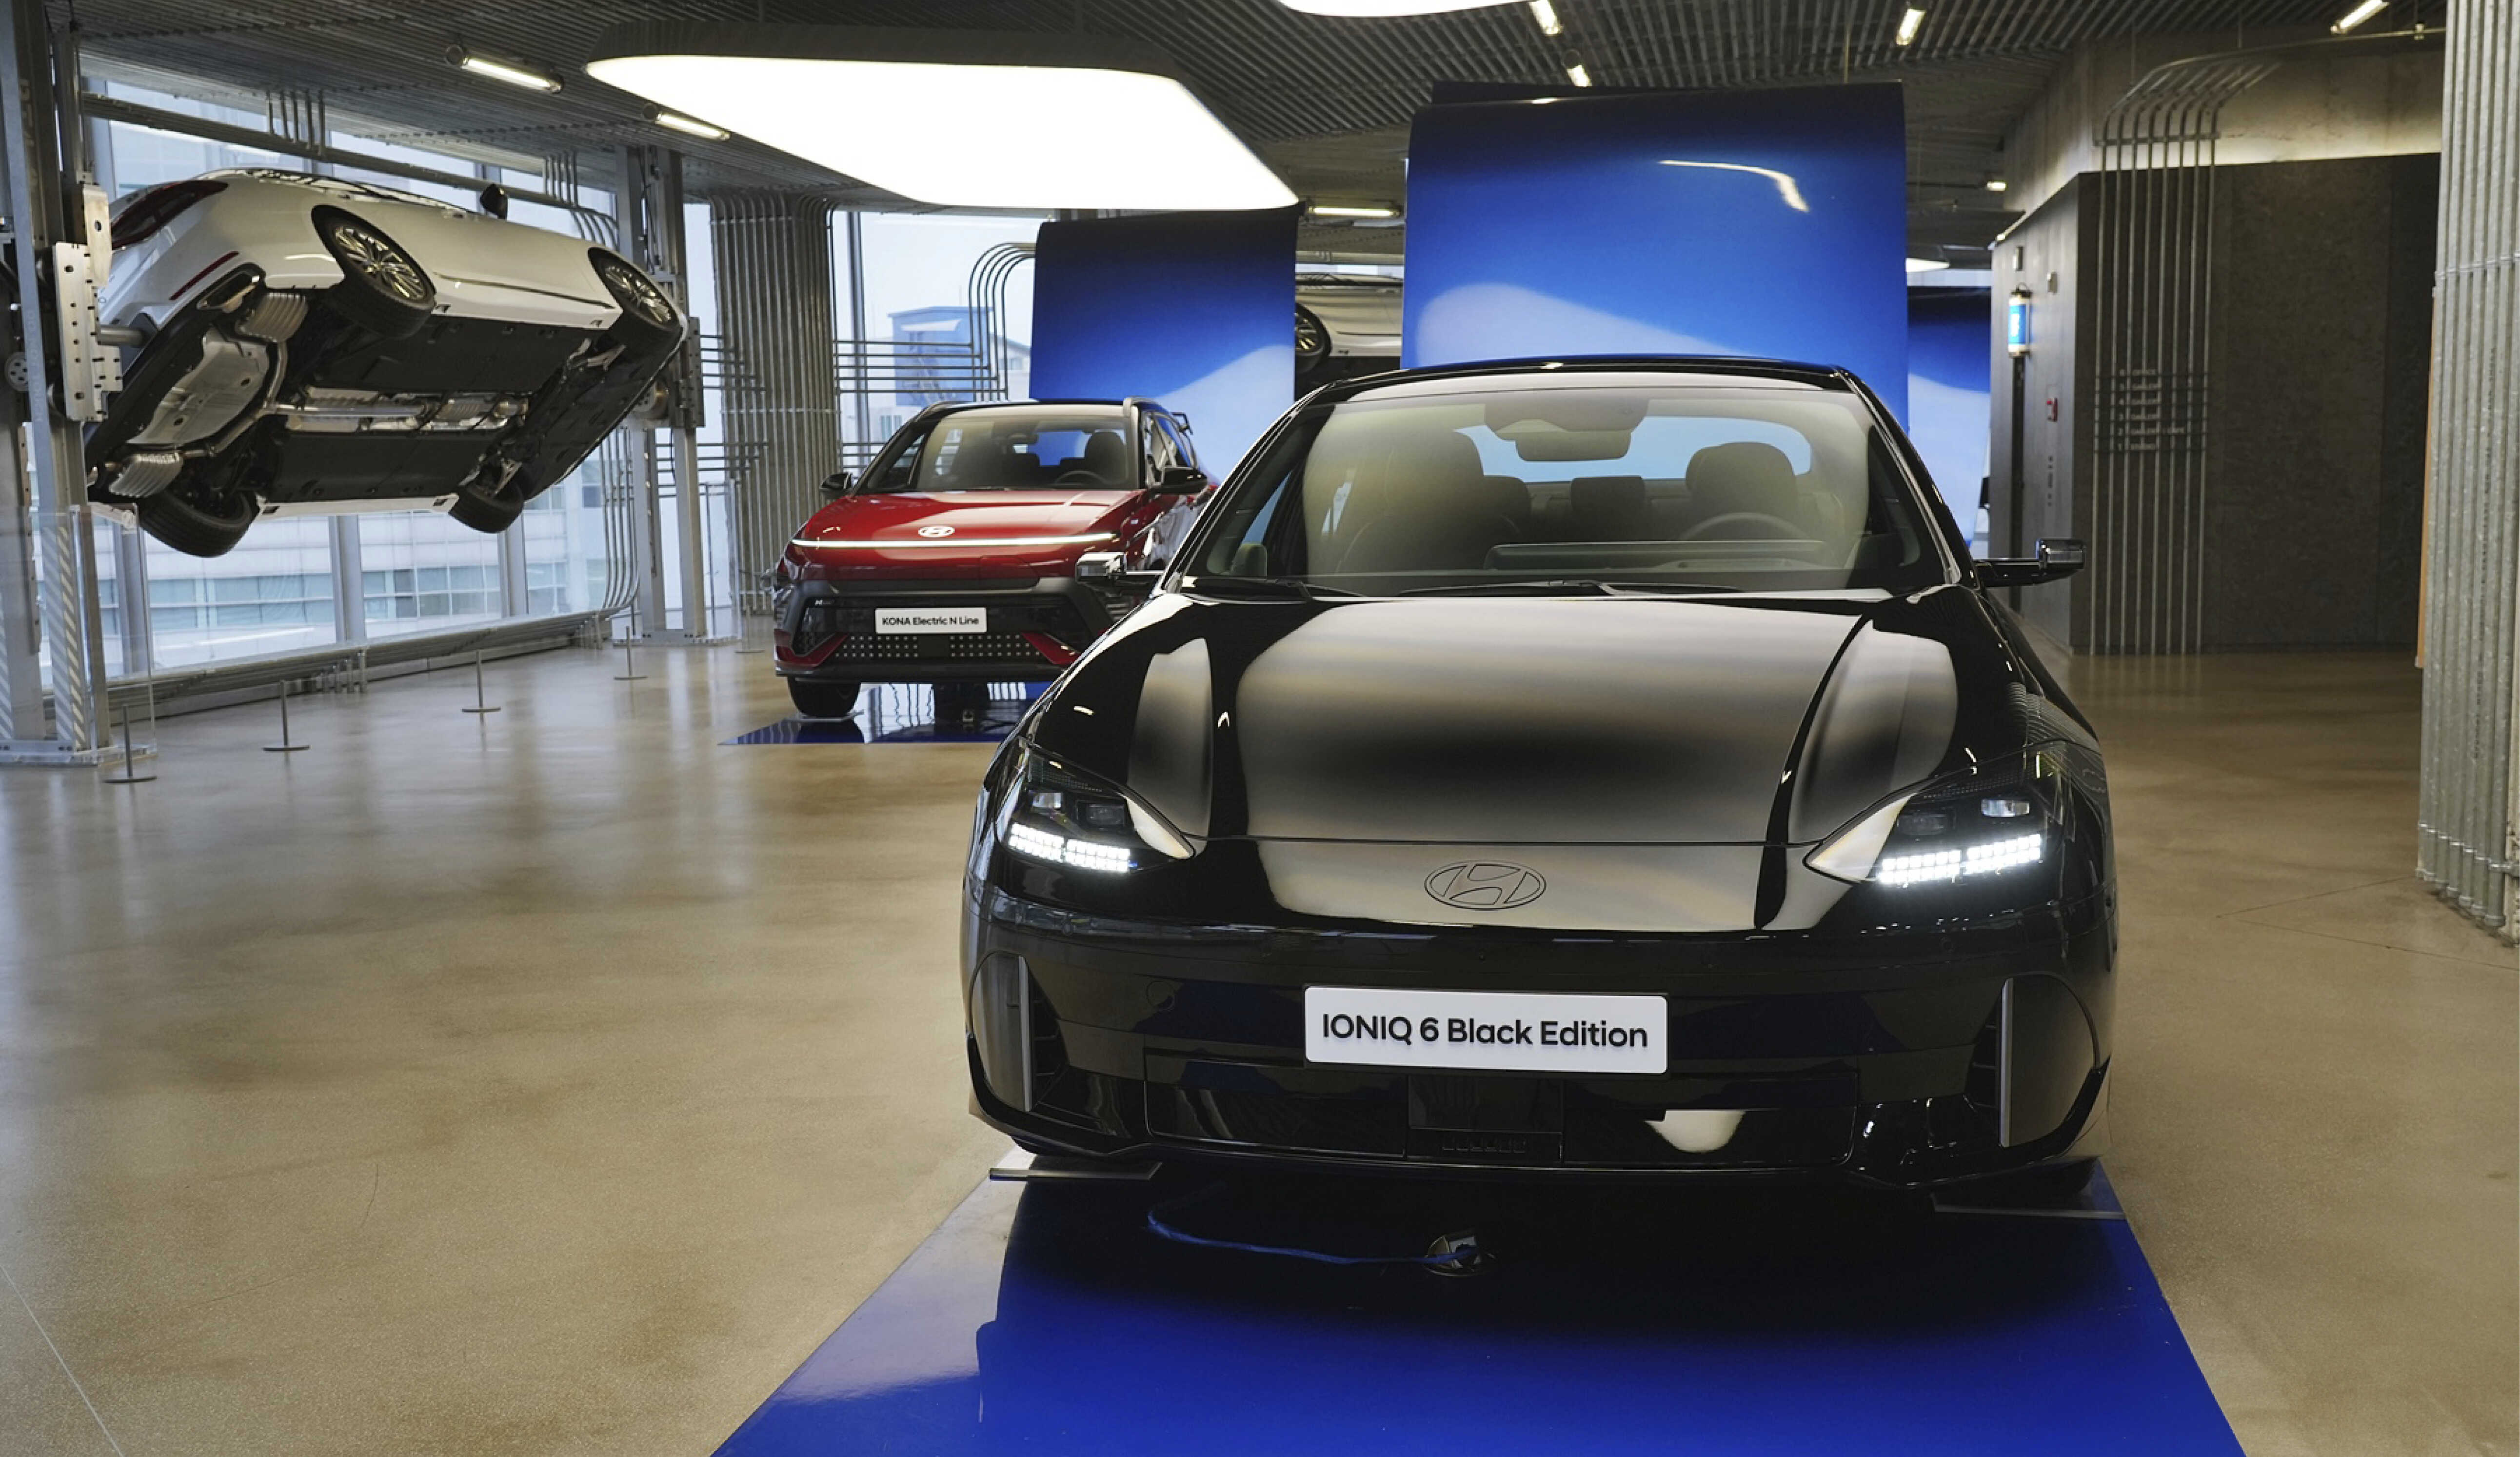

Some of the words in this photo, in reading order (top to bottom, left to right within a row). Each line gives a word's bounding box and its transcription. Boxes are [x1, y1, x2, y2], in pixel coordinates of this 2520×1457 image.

[882, 617, 911, 625] KONA
[913, 617, 948, 625] Electric
[949, 617, 957, 625] N
[959, 615, 979, 625] Line
[1323, 1014, 1412, 1045] IONIQ
[1420, 1017, 1439, 1041] 6
[1447, 1018, 1534, 1044] Black
[1541, 1019, 1648, 1047] Edition
